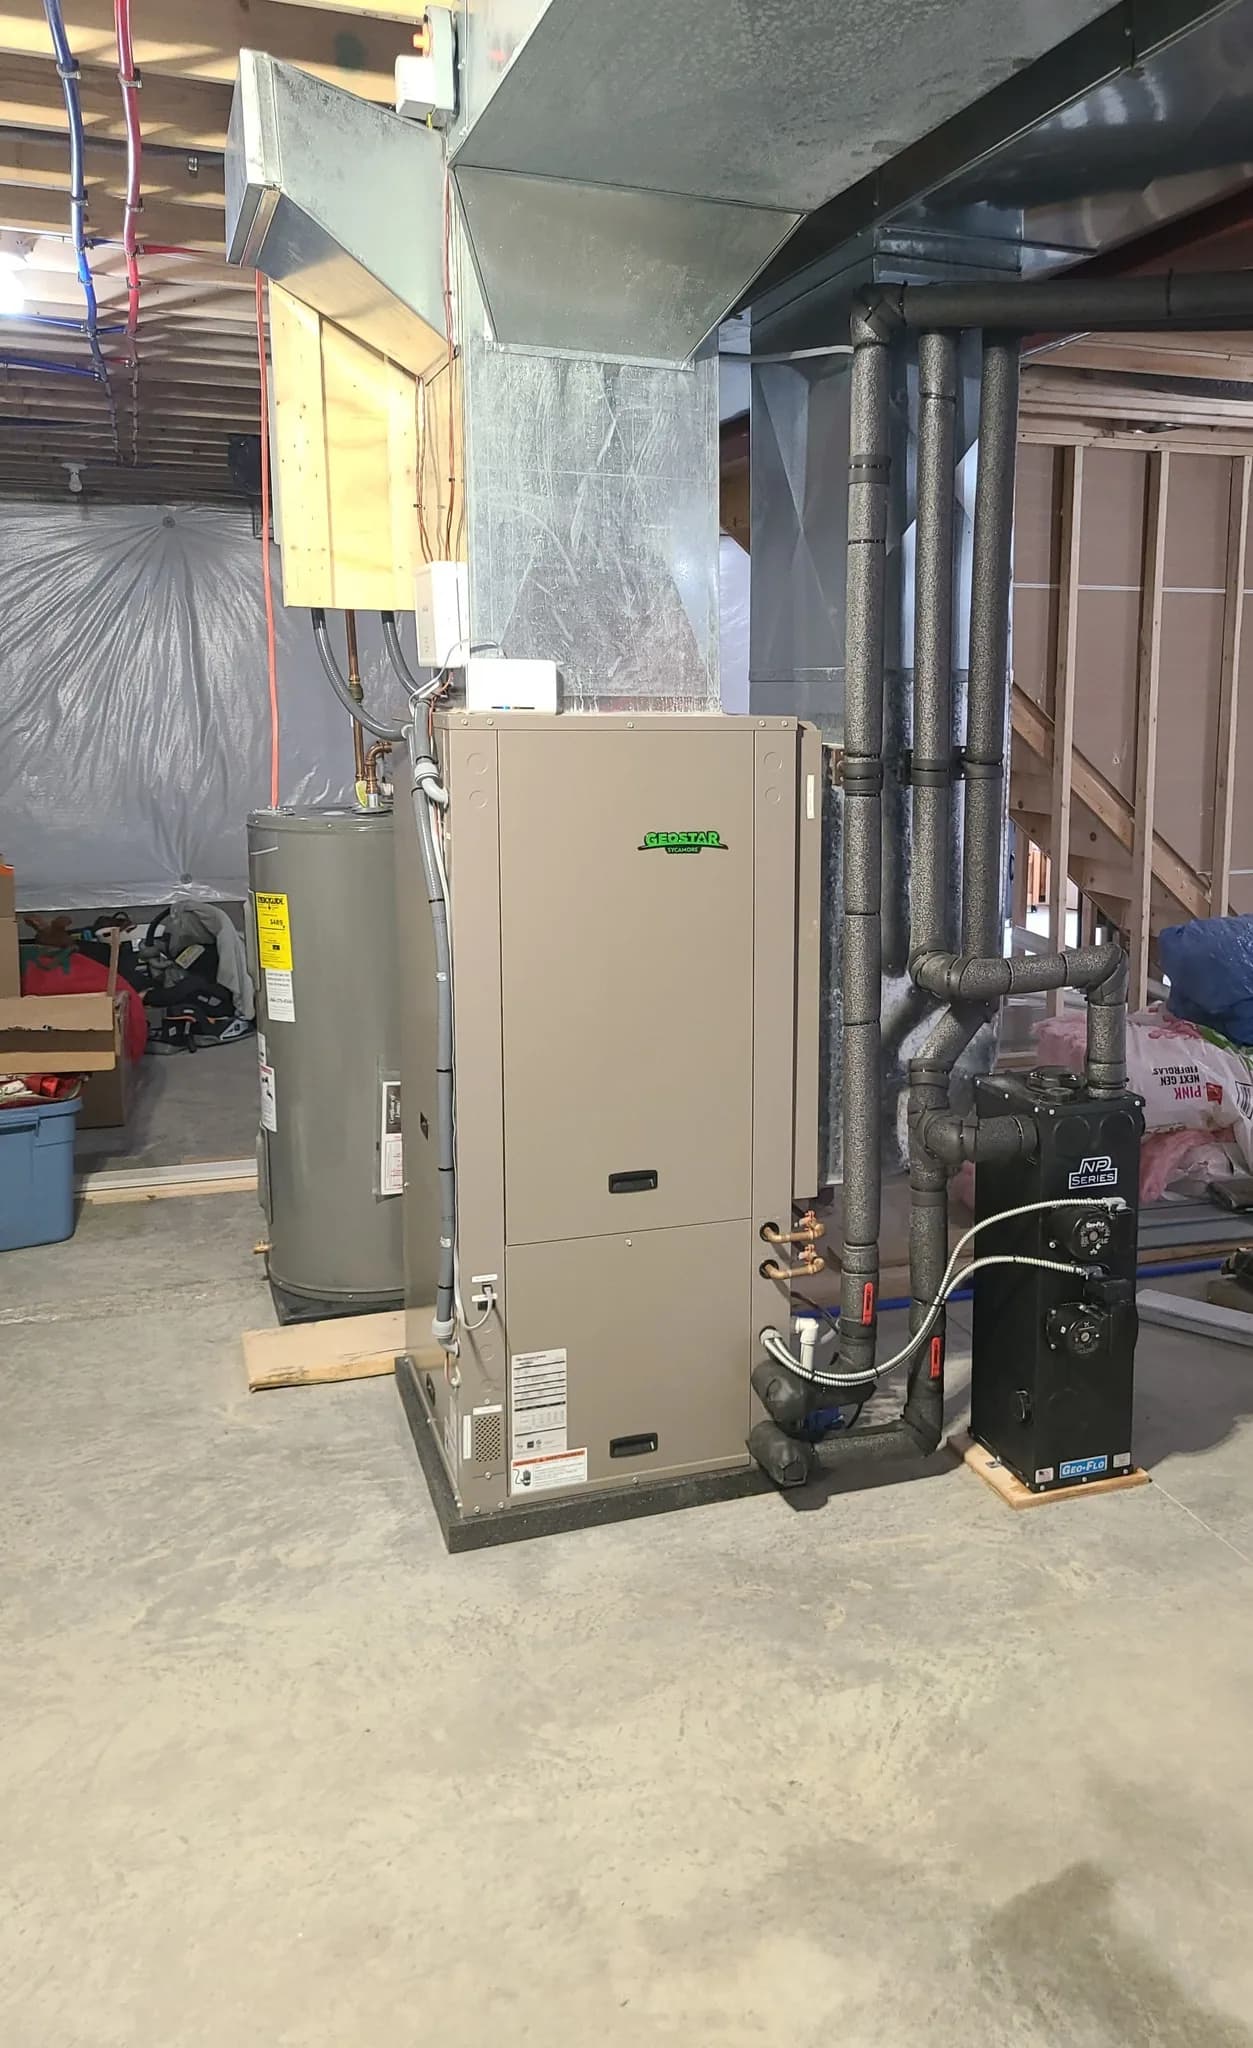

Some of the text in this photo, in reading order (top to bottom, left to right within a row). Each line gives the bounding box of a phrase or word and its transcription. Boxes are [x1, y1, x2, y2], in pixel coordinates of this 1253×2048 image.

[644, 831, 720, 846] GEOSTAR
[1160, 1075, 1200, 1086] NEXT GEN
[1174, 1084, 1202, 1100] PINK
[1083, 1161, 1108, 1174] NP
